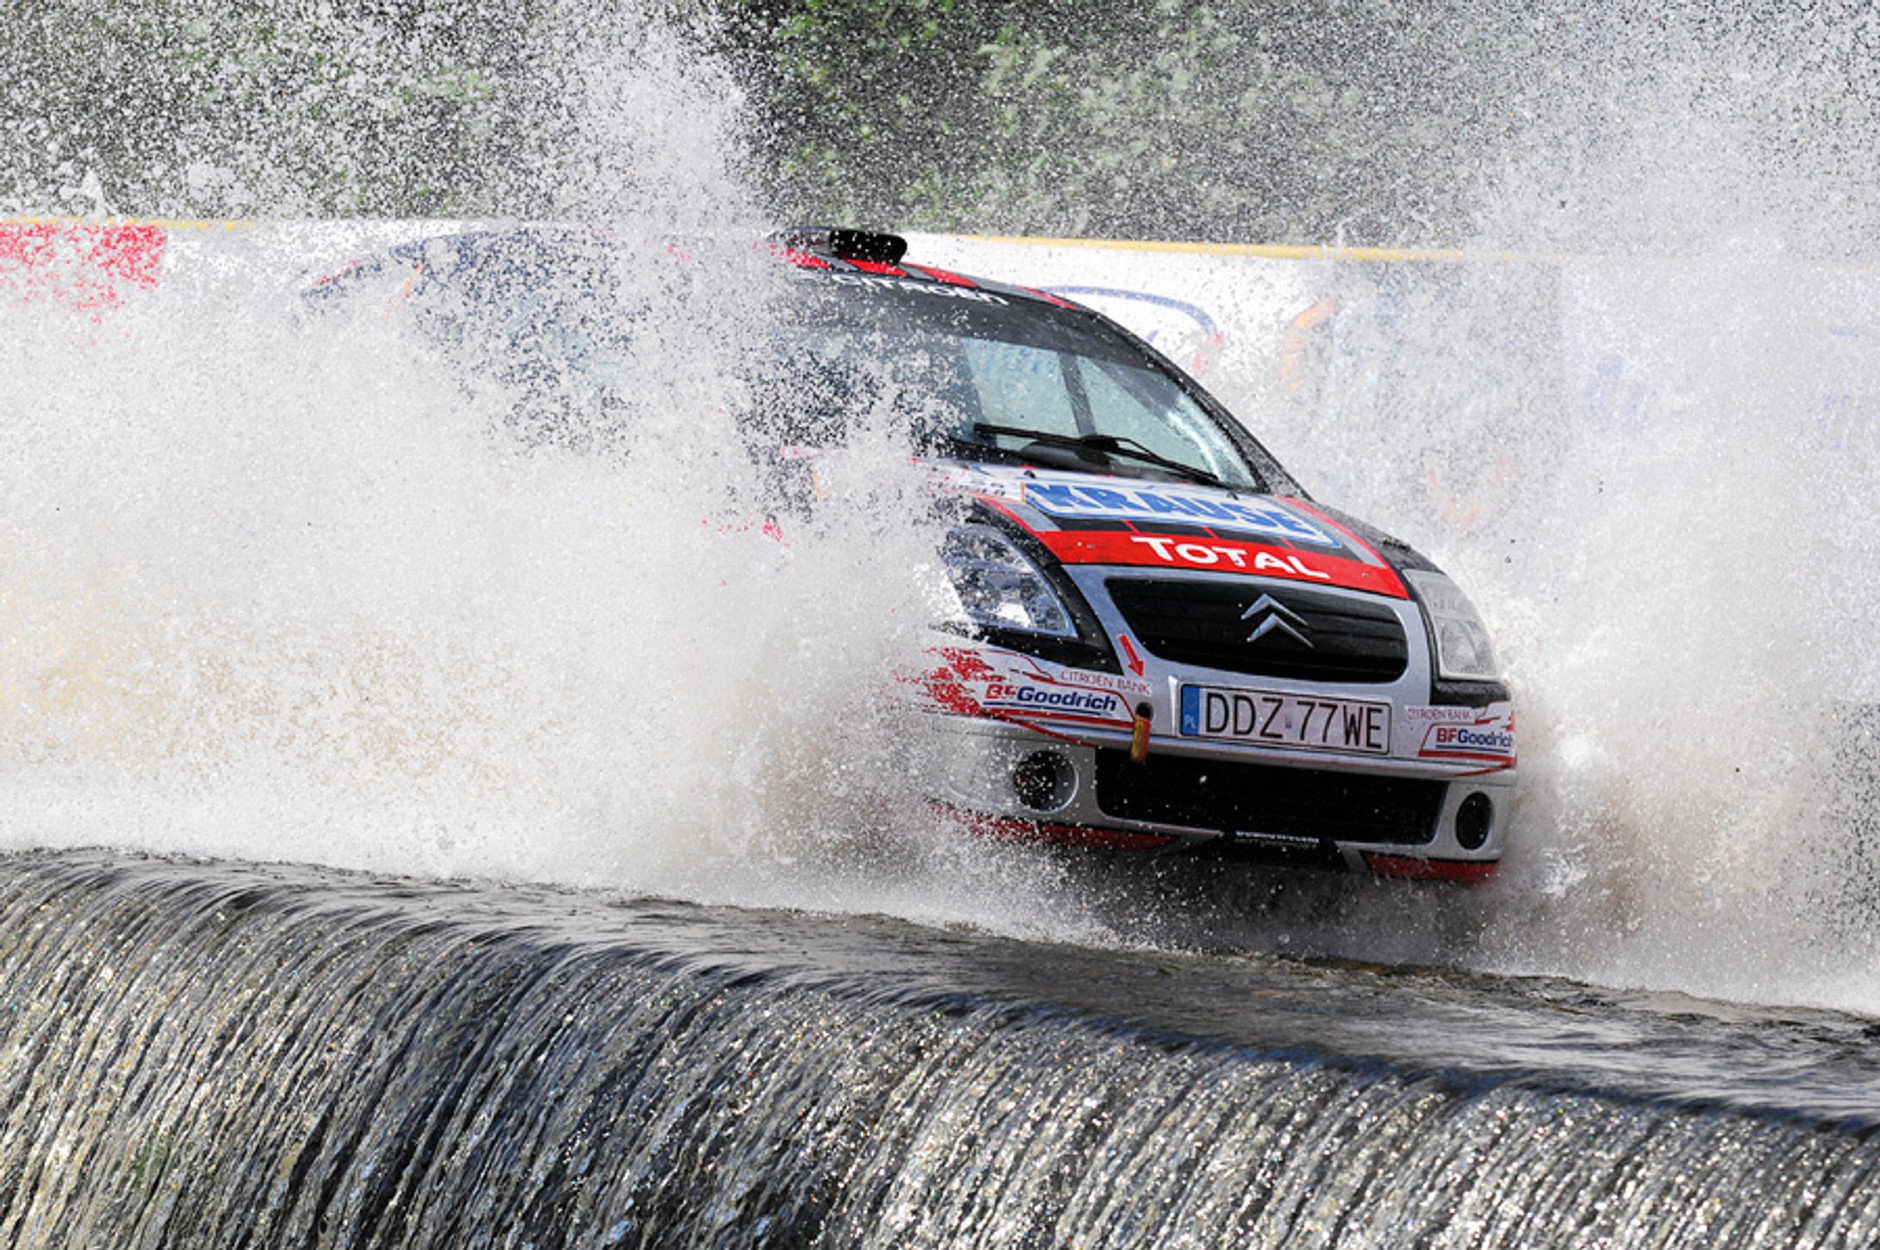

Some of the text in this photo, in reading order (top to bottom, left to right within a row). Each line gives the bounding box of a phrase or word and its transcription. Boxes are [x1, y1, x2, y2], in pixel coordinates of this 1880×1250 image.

[1025, 482, 1323, 538] KRAUSE
[1130, 535, 1331, 580] TOTAL
[985, 683, 1117, 712] BFGoodrich
[1118, 677, 1151, 695] BANK
[1205, 692, 1384, 749] DDZ 77WE
